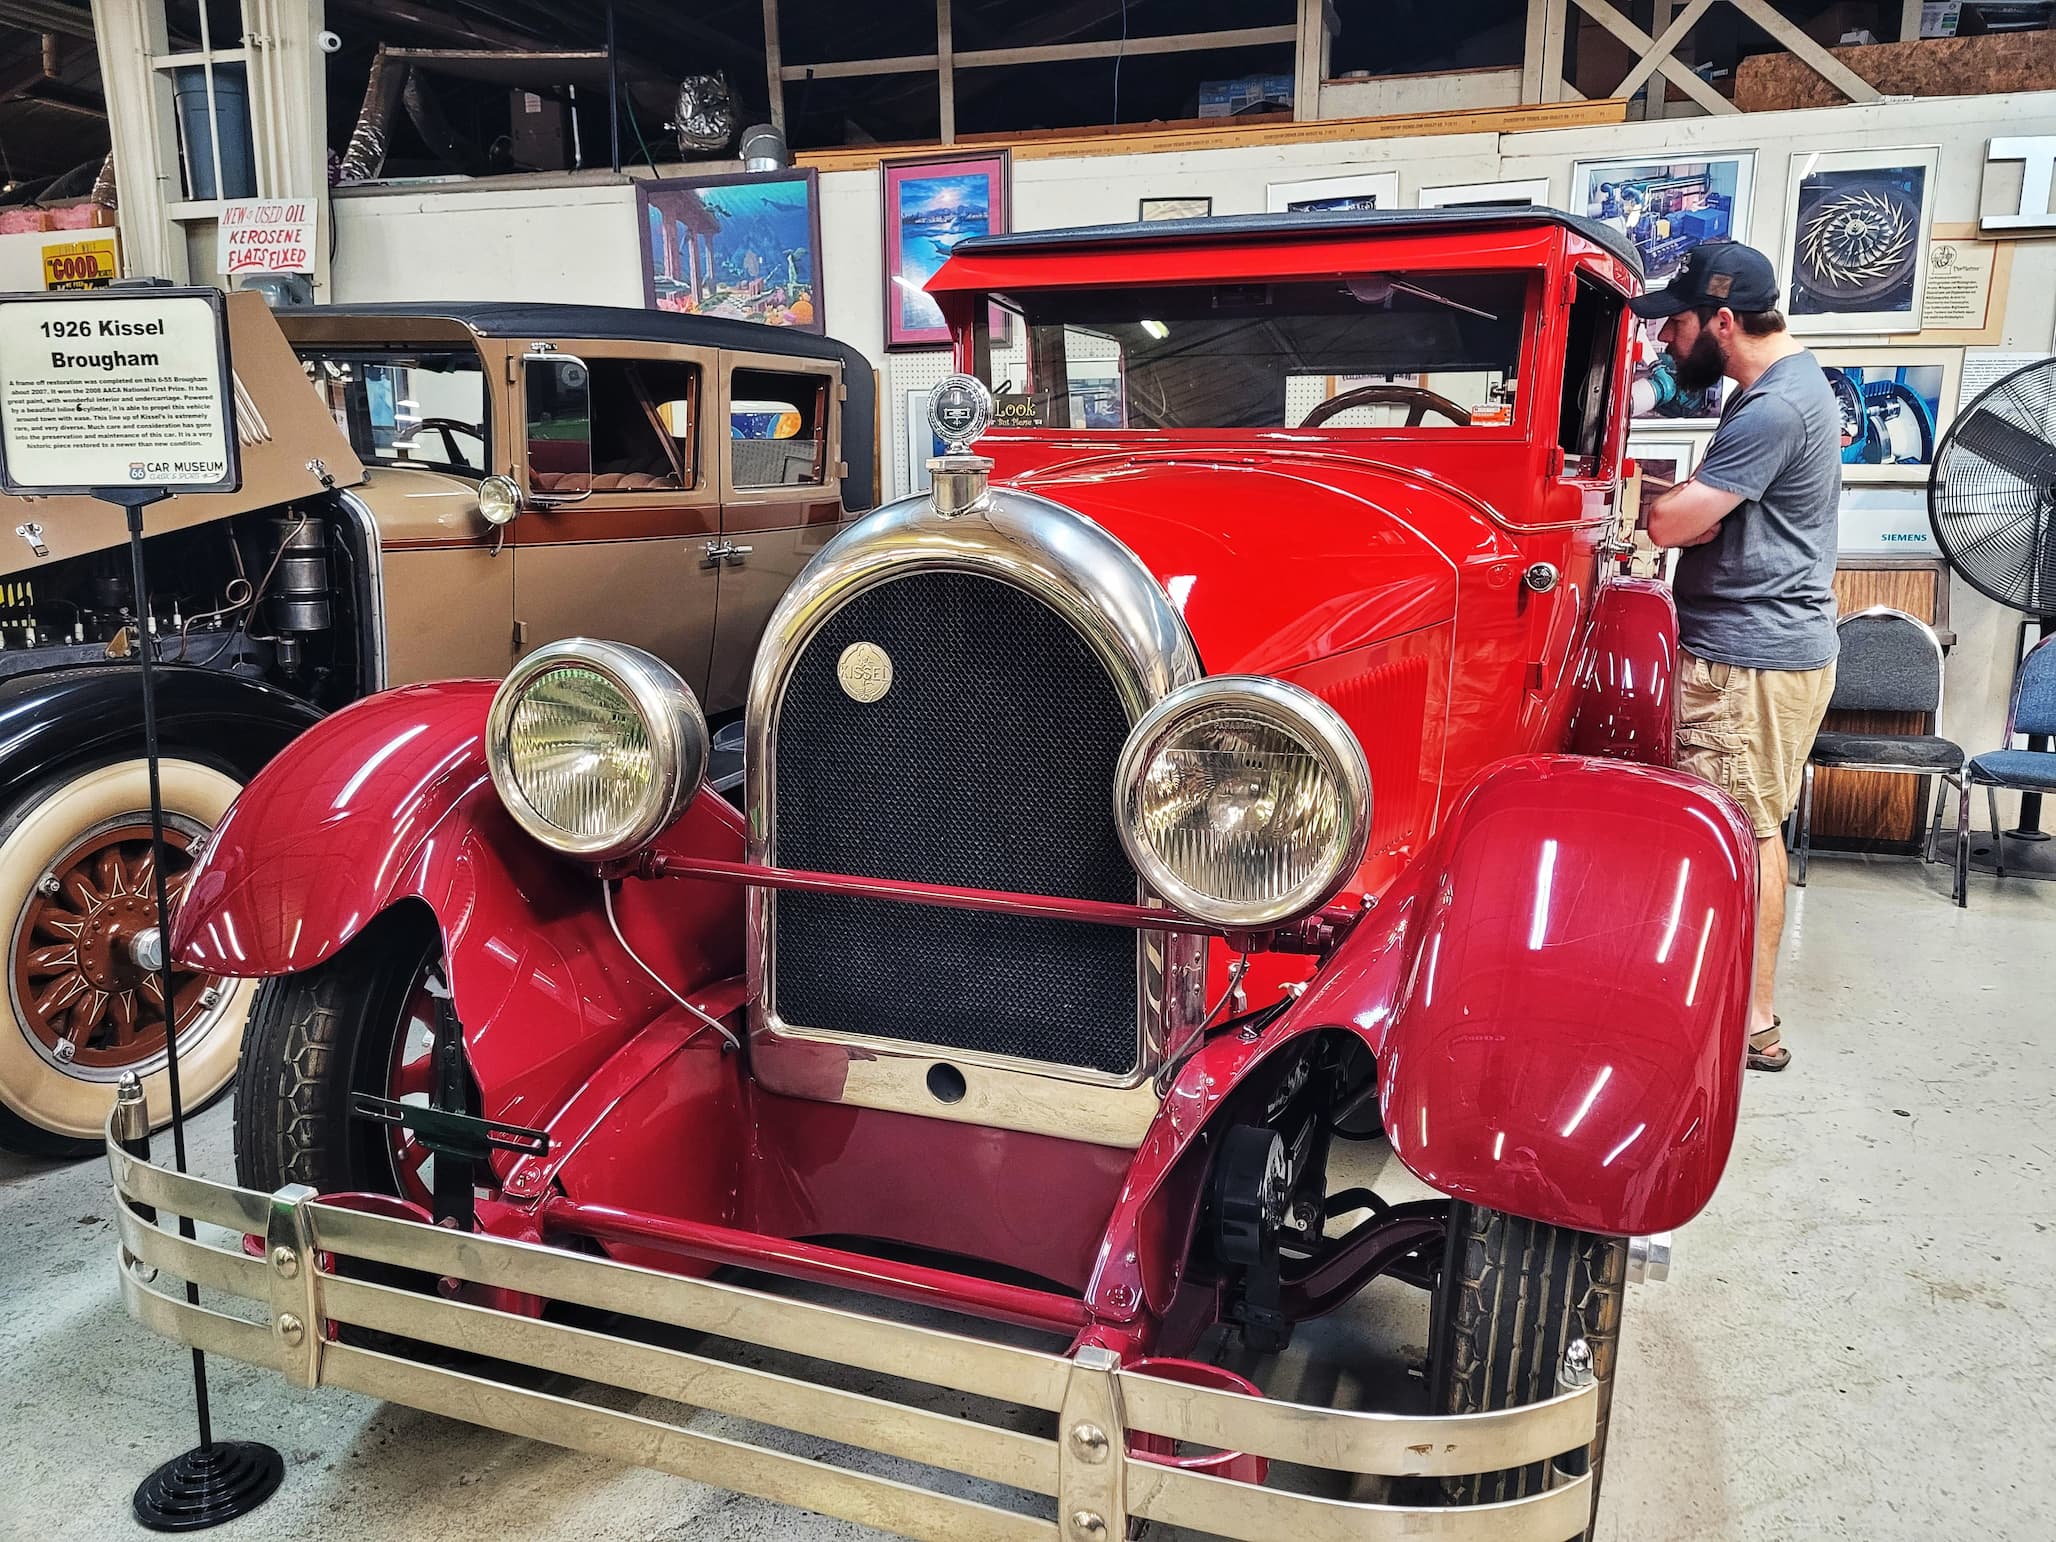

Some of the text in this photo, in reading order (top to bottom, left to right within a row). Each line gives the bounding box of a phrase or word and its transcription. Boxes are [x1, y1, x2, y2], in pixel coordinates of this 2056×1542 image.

[223, 207, 248, 225] NEW
[255, 206, 283, 224] USED
[285, 204, 305, 223] OIL
[229, 229, 303, 244] KEROSENE
[228, 248, 306, 267] FLATS FIXED
[53, 255, 99, 281] GOOD
[41, 319, 164, 338] 1926 Kissel
[51, 350, 159, 371] Brougham
[994, 396, 1036, 417] Look
[132, 462, 224, 478] 66 CAR MUSEUM
[840, 664, 890, 682] KISSEL
